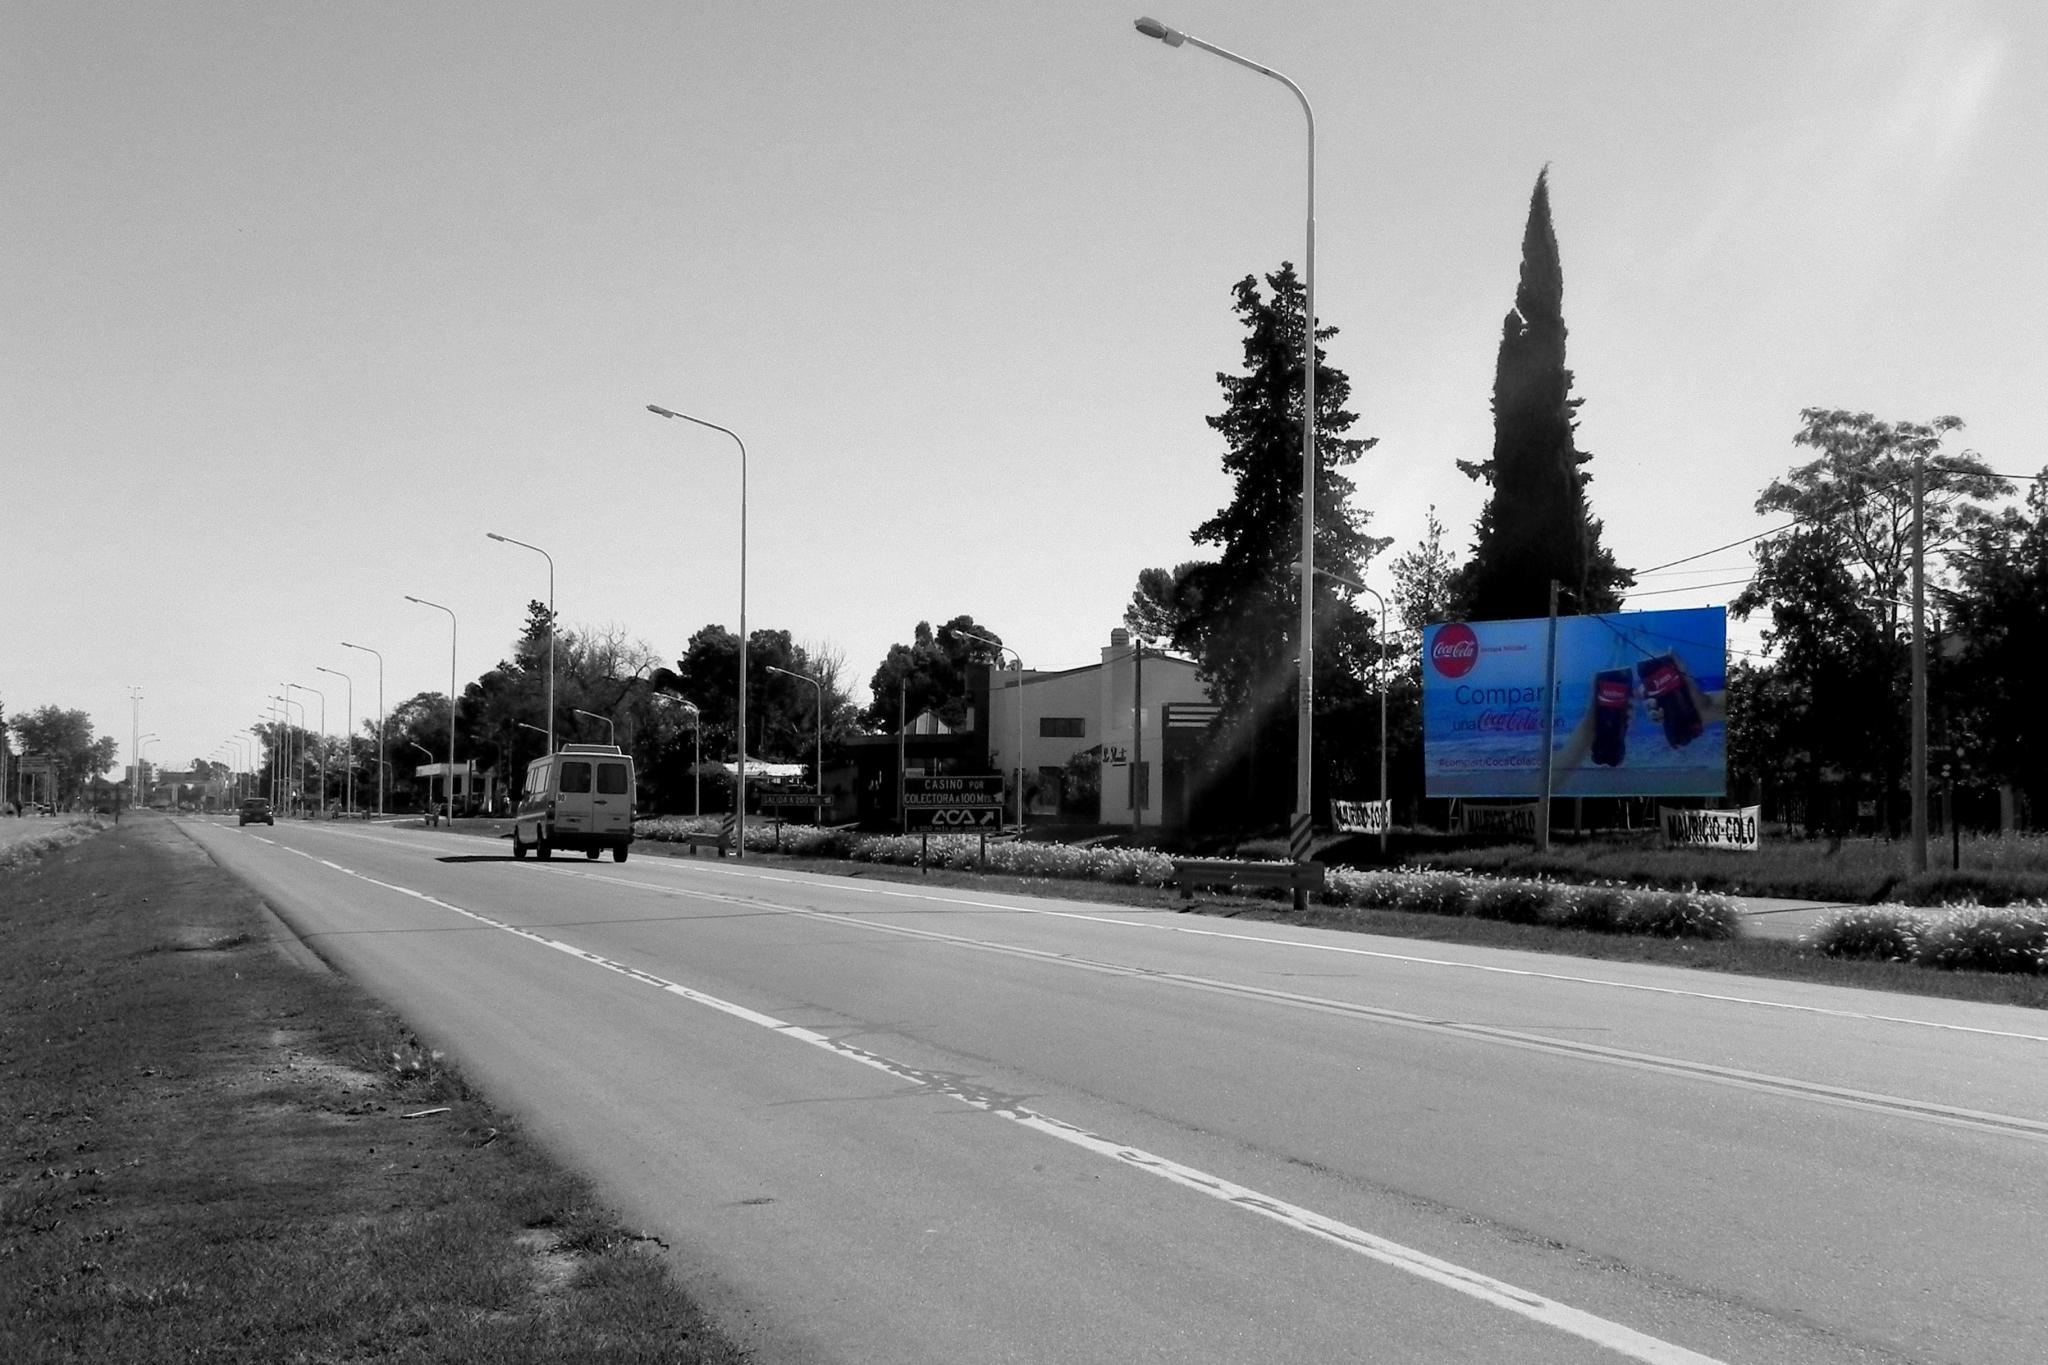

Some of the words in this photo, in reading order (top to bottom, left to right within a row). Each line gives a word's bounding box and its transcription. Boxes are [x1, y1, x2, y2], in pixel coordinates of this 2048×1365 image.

[1455, 680, 1562, 706] Comparí
[1452, 718, 1476, 731] una
[924, 779, 963, 790] CASINO
[968, 780, 984, 790] POR
[904, 793, 955, 804] COLECTORA
[931, 809, 976, 825] ACA
